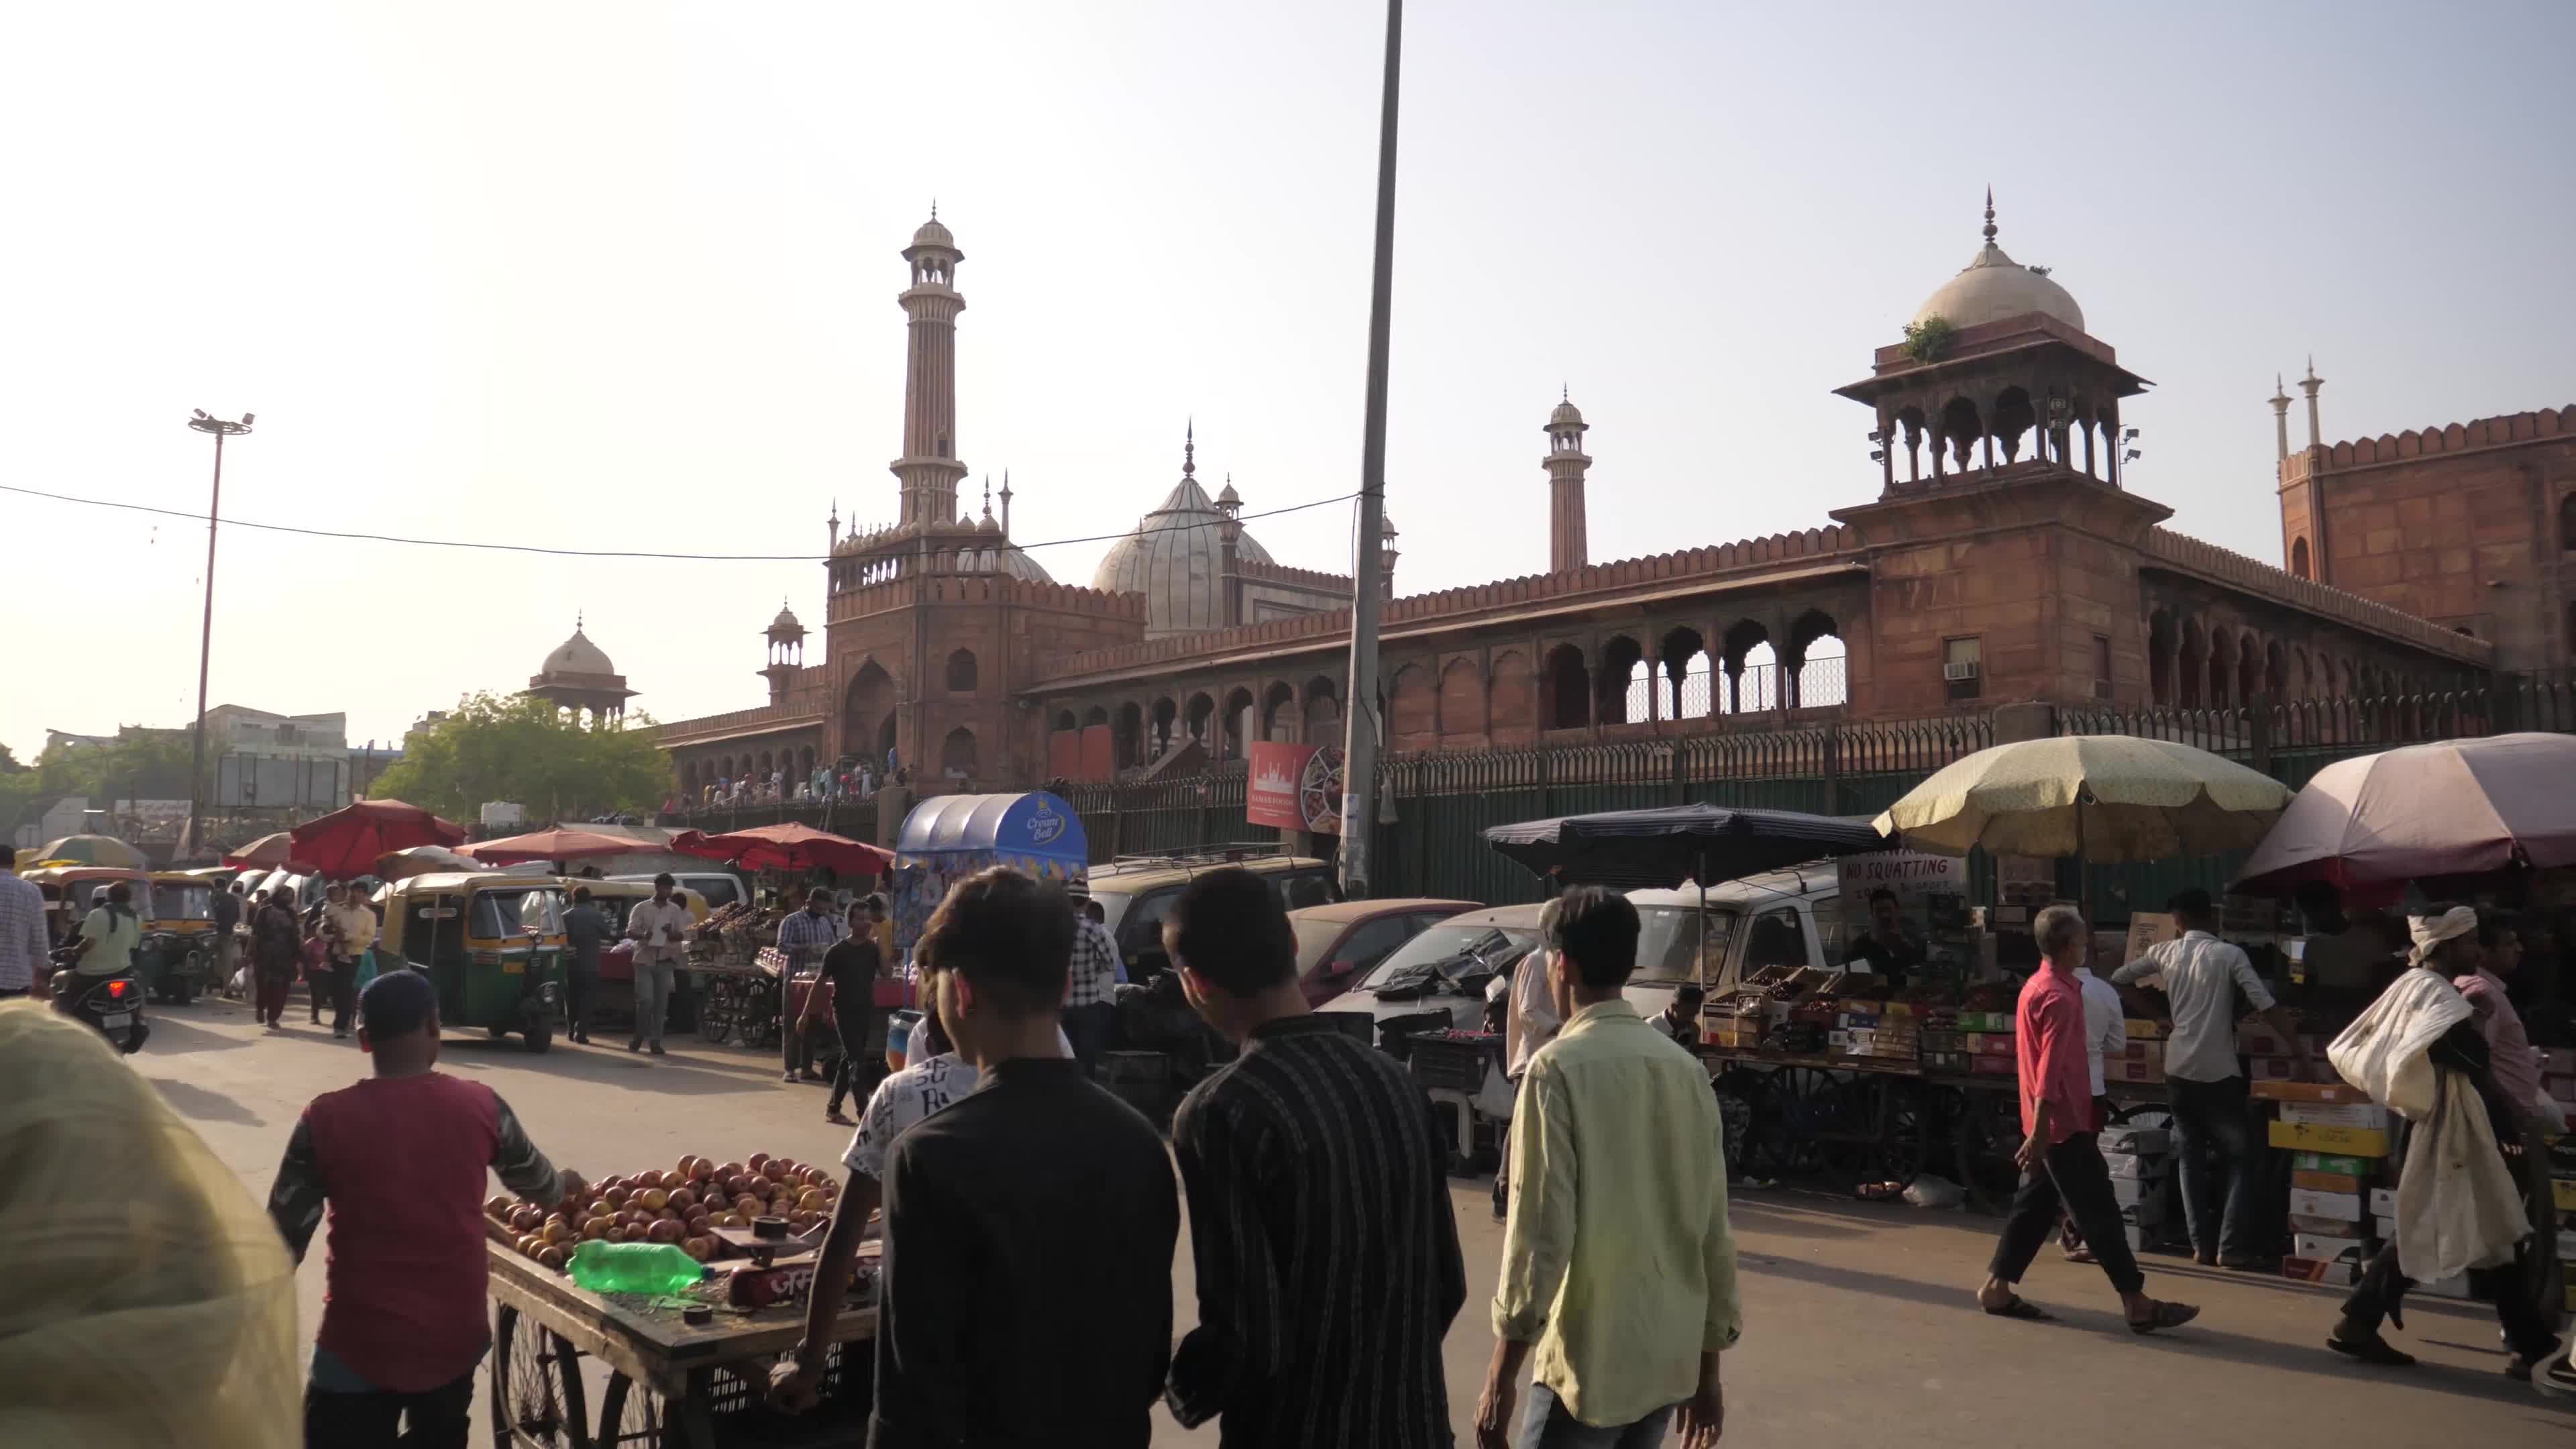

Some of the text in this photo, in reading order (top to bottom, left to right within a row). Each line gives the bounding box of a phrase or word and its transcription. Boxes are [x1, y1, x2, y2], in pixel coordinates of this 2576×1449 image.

[1026, 818, 1059, 830] Cream
[1034, 827, 1053, 841] Bell
[1845, 859, 1948, 881] NO SQUATTING
